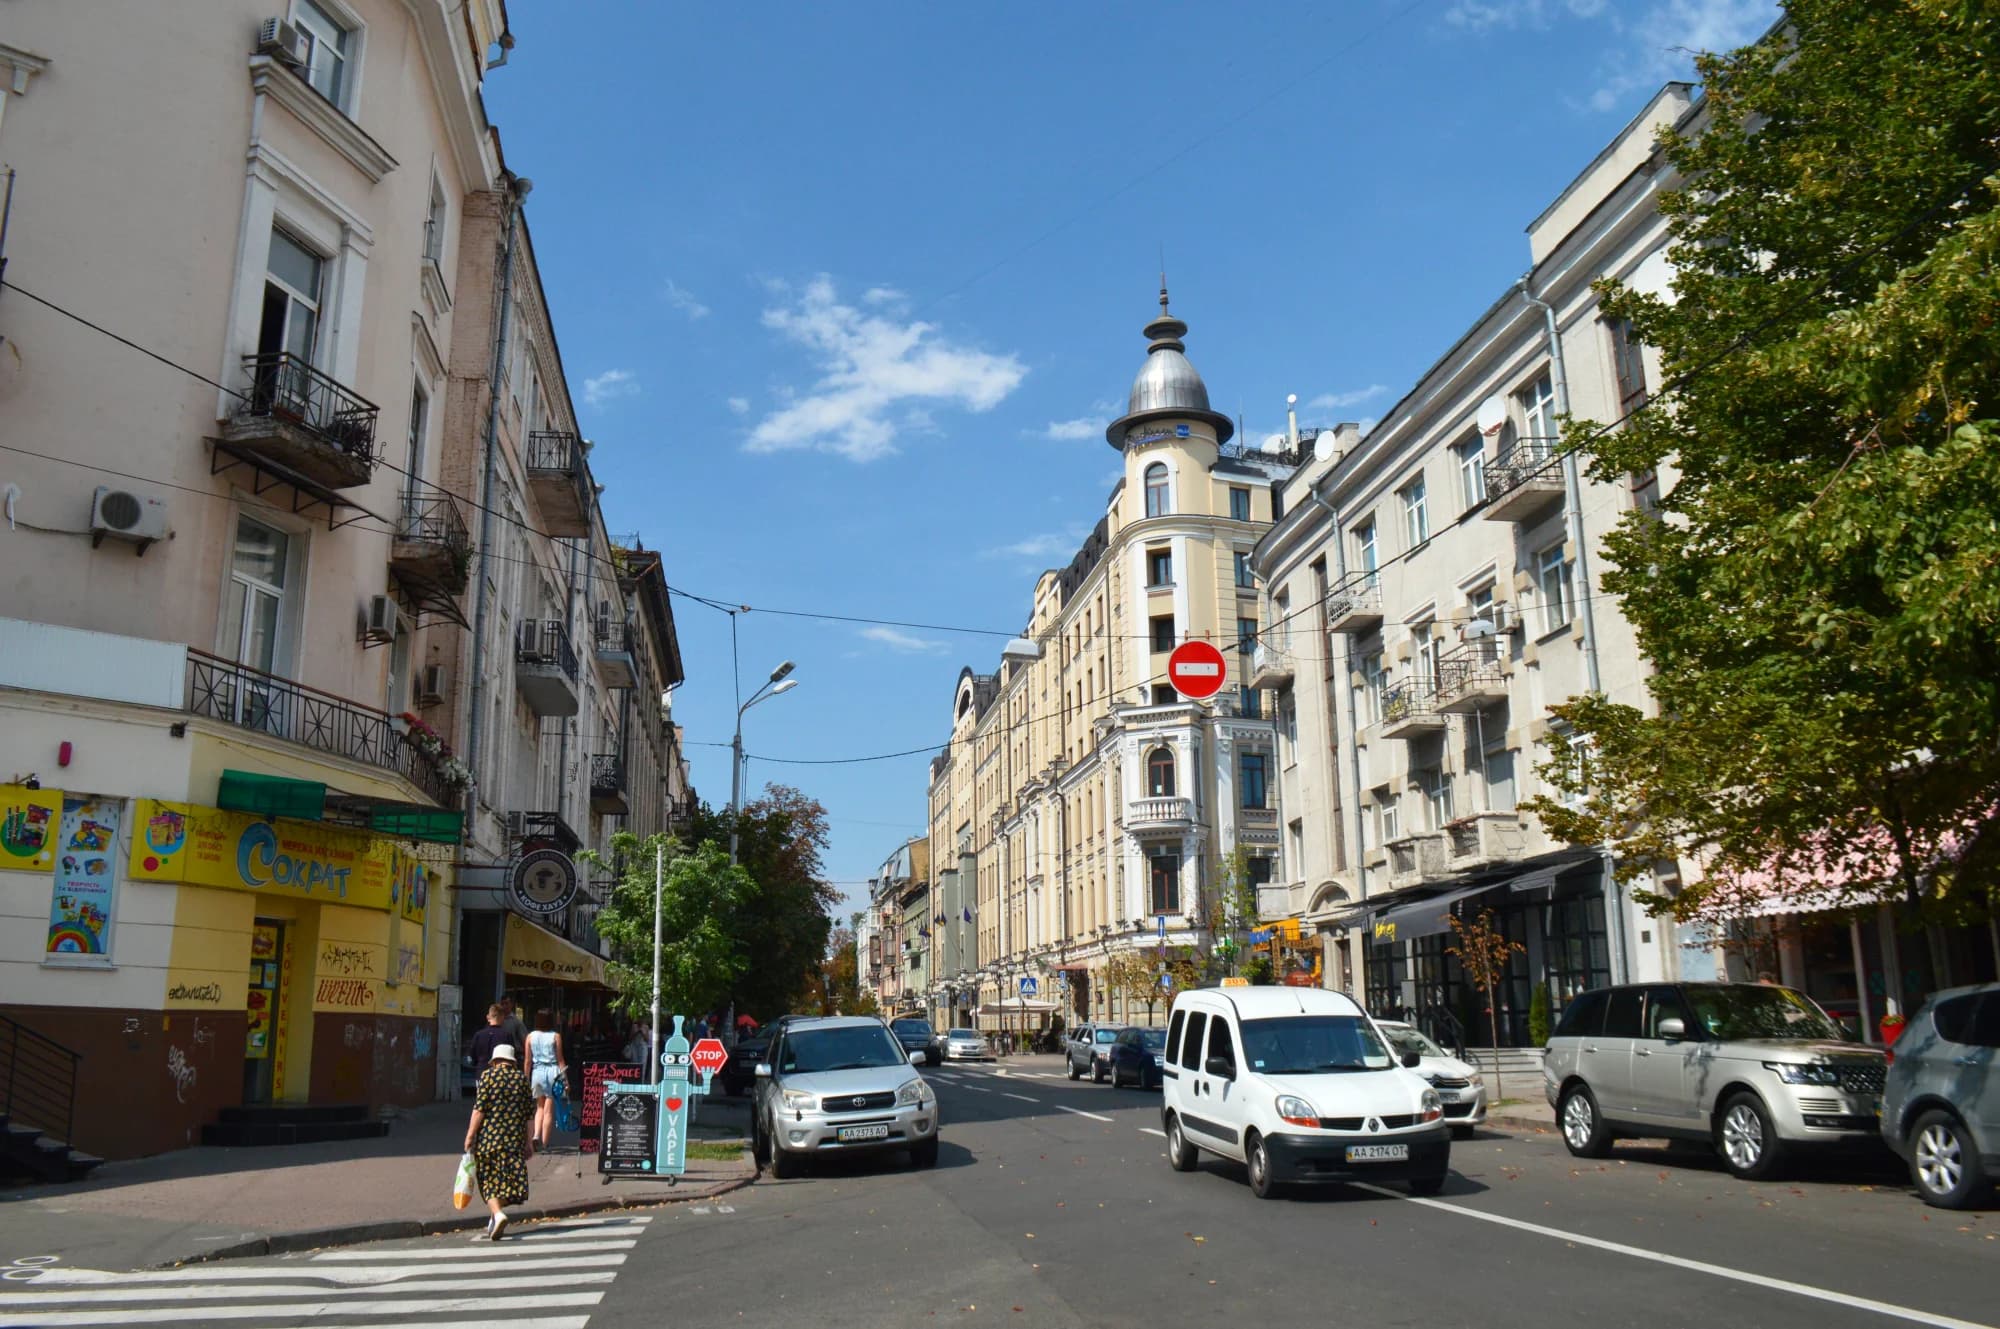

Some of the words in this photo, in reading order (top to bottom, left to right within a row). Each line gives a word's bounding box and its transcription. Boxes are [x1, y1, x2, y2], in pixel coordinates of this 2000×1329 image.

[520, 894, 541, 911] КОФЕ
[542, 899, 564, 911] ХАУЗ
[511, 959, 538, 970] КОФЕ
[557, 964, 584, 975] ХАУЗ
[275, 942, 291, 1089] SOUVENIRS
[696, 1051, 722, 1060] STOP
[671, 1084, 677, 1095] I
[667, 1114, 679, 1165] VAPE
[1354, 1147, 1367, 1157] AA
[1369, 1146, 1391, 1157] 2174
[1392, 1145, 1405, 1156] OT
